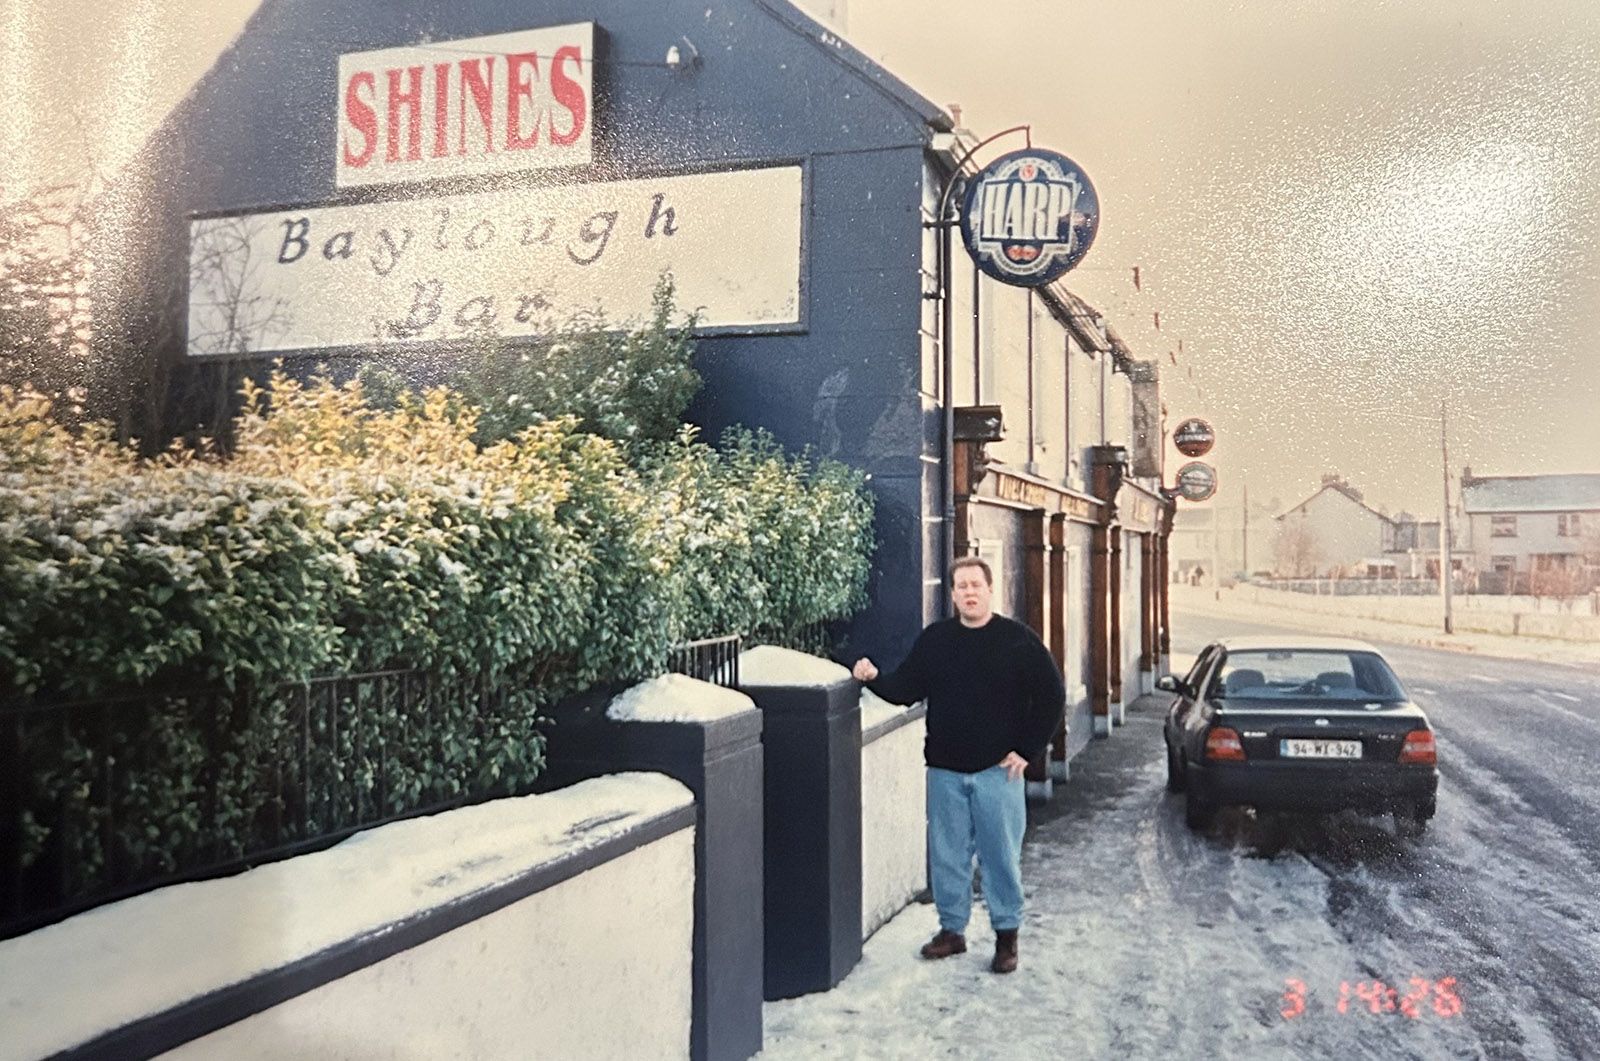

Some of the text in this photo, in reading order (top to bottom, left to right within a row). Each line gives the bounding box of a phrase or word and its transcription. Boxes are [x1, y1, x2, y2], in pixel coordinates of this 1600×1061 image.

[343, 46, 587, 168] SHINES
[277, 192, 679, 277] Baylough
[982, 182, 1071, 241] HARP
[405, 279, 552, 334] Bar
